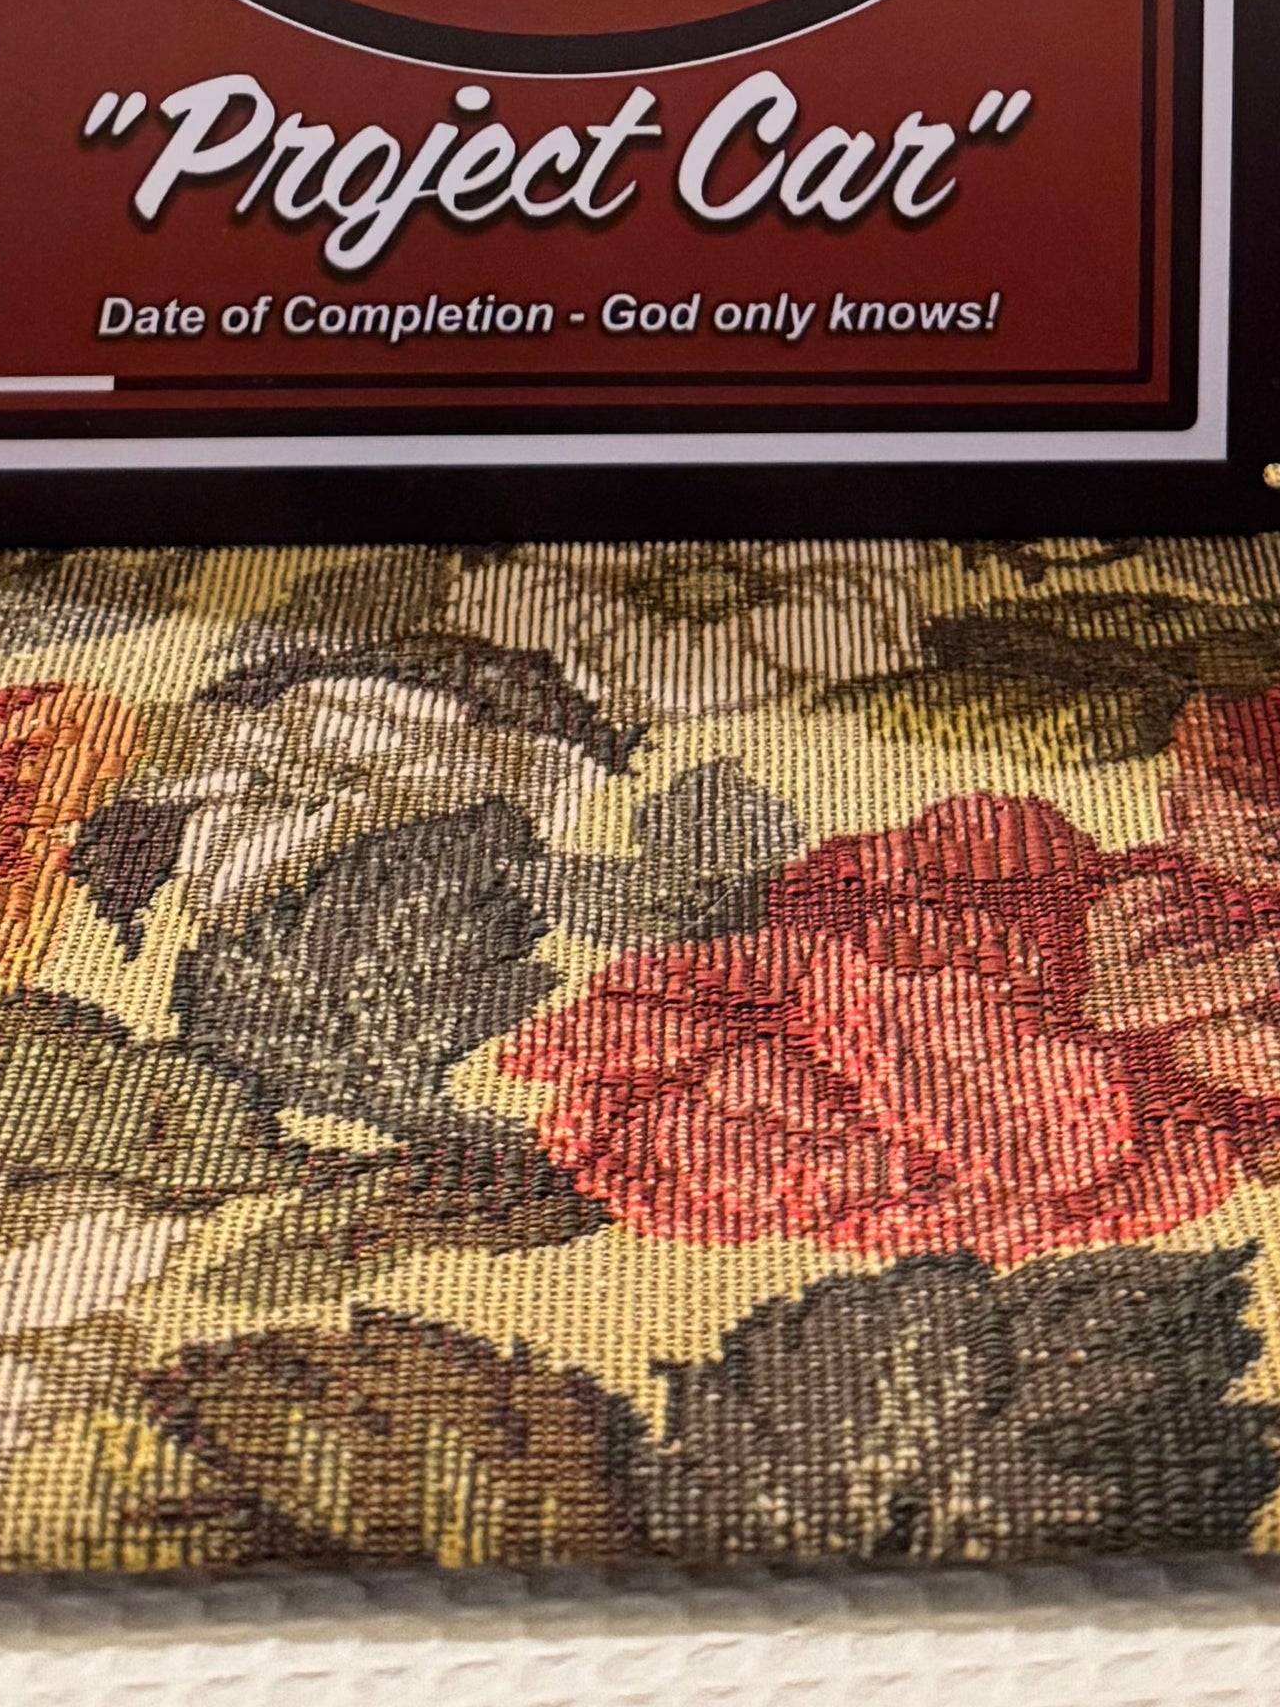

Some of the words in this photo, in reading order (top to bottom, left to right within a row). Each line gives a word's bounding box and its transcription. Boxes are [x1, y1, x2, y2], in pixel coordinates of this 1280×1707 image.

[98, 294, 206, 336] Date
[221, 293, 272, 336] of
[282, 293, 555, 344] Completion
[601, 292, 702, 332] God
[713, 291, 817, 342] only
[828, 290, 1001, 331] knows!
